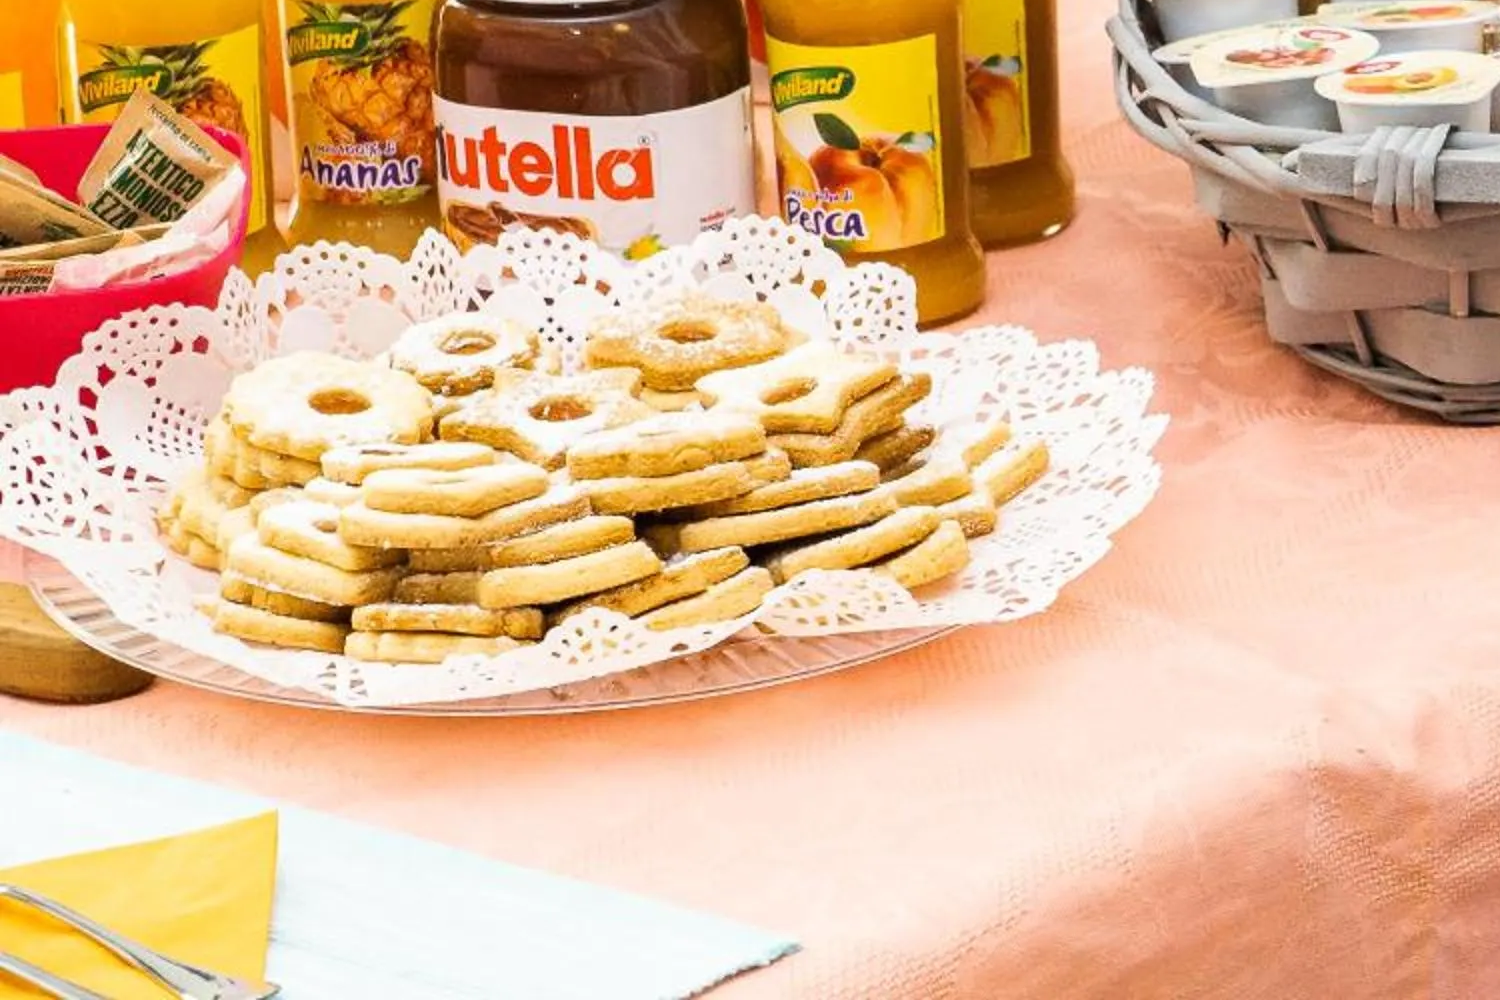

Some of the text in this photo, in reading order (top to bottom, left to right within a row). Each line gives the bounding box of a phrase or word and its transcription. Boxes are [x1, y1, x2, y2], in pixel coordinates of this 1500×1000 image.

[109, 162, 188, 223] MONIOS
[125, 128, 205, 202] ATENTICO
[436, 123, 655, 201] utella
